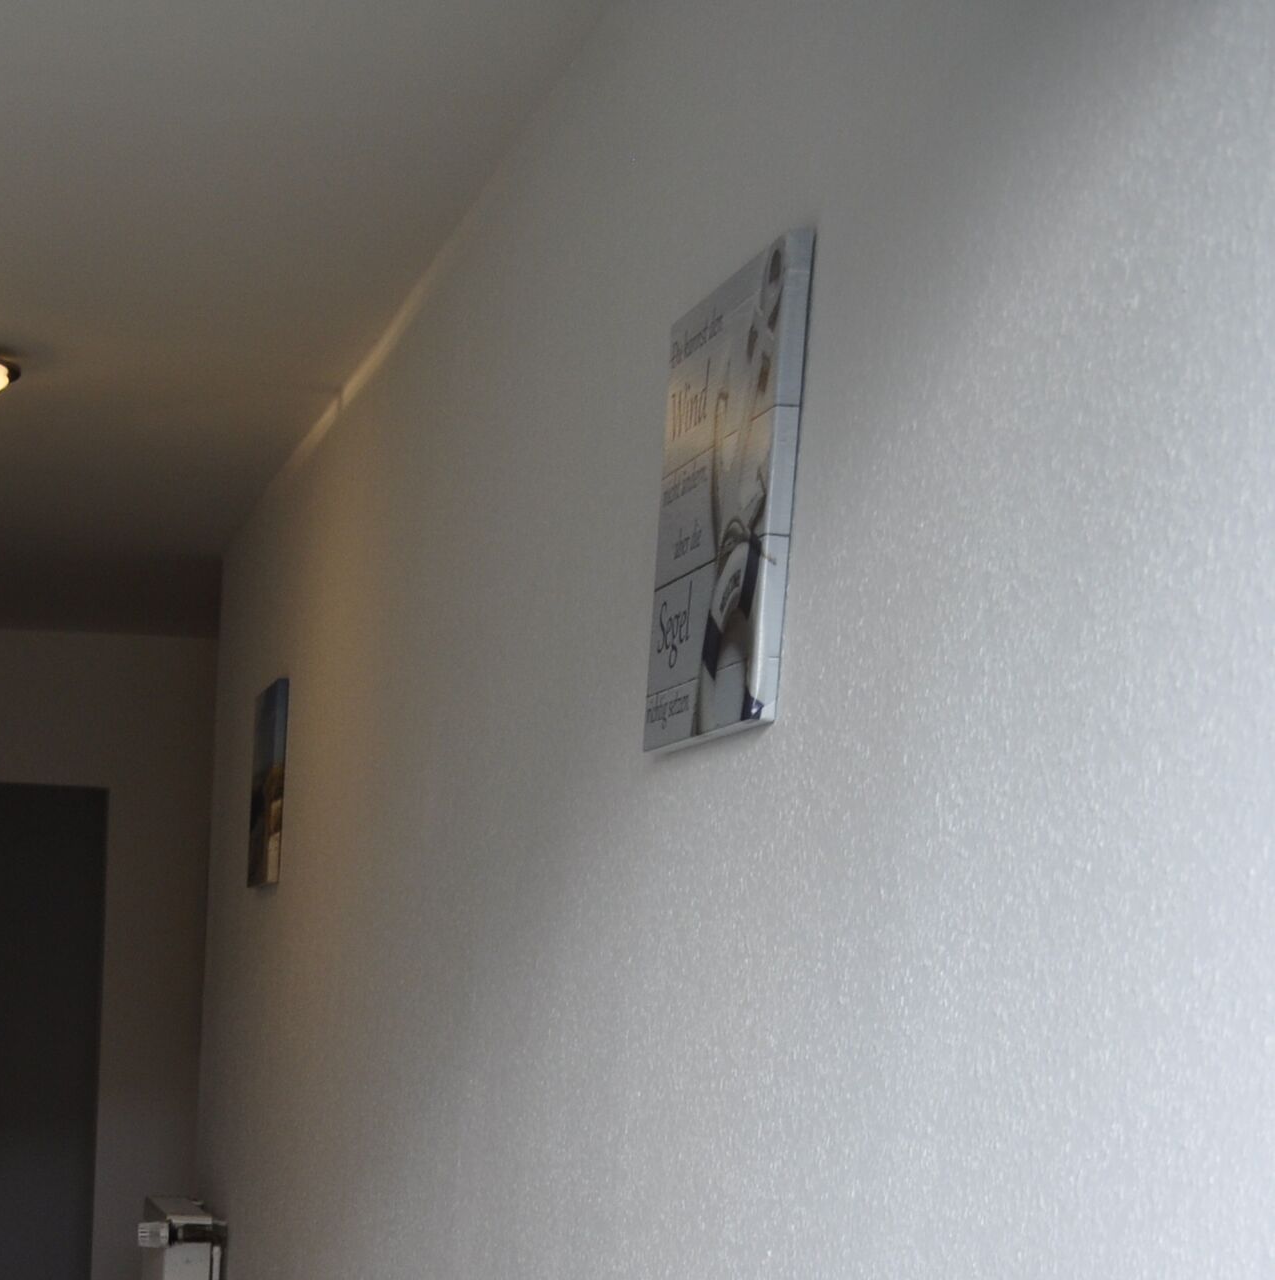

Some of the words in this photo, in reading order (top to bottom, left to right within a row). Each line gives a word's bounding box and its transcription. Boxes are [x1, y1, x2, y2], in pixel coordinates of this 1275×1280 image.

[671, 357, 711, 441] Wind
[656, 580, 693, 669] Segel
[646, 694, 668, 730] richtig
